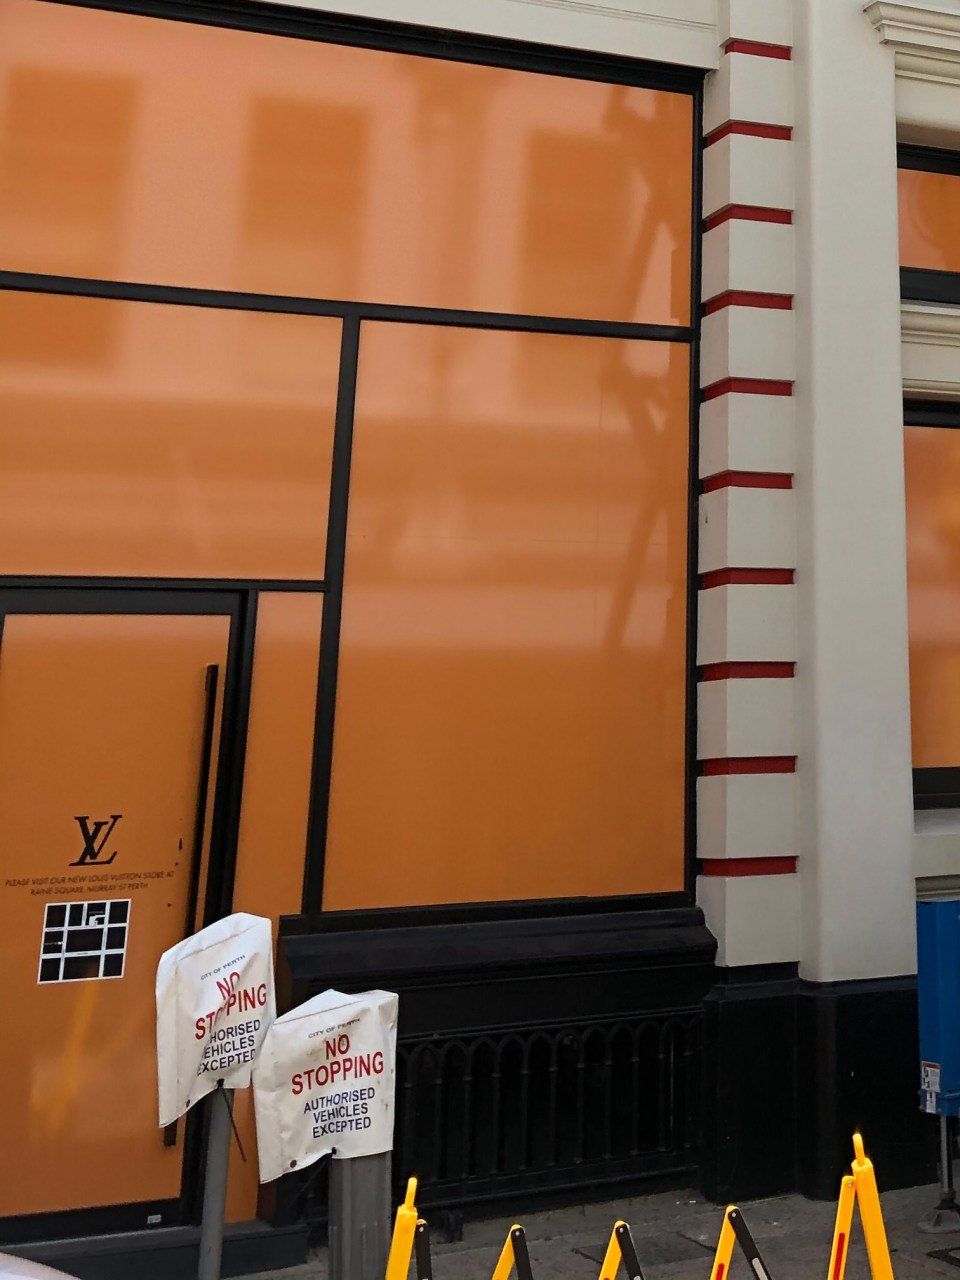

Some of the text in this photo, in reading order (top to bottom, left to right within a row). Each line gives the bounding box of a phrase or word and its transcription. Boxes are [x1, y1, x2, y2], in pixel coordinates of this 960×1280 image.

[200, 972, 212, 981] CITY
[222, 954, 246, 970] PERTH
[308, 1030, 325, 1039] CITY
[325, 1034, 350, 1060] NO
[202, 1035, 255, 1060] EHICLES
[291, 1051, 384, 1095] STOPPING
[303, 1087, 375, 1114] AUTHORISED
[313, 1102, 369, 1124] VEHICLES
[312, 1116, 372, 1139] EXCEPTED
